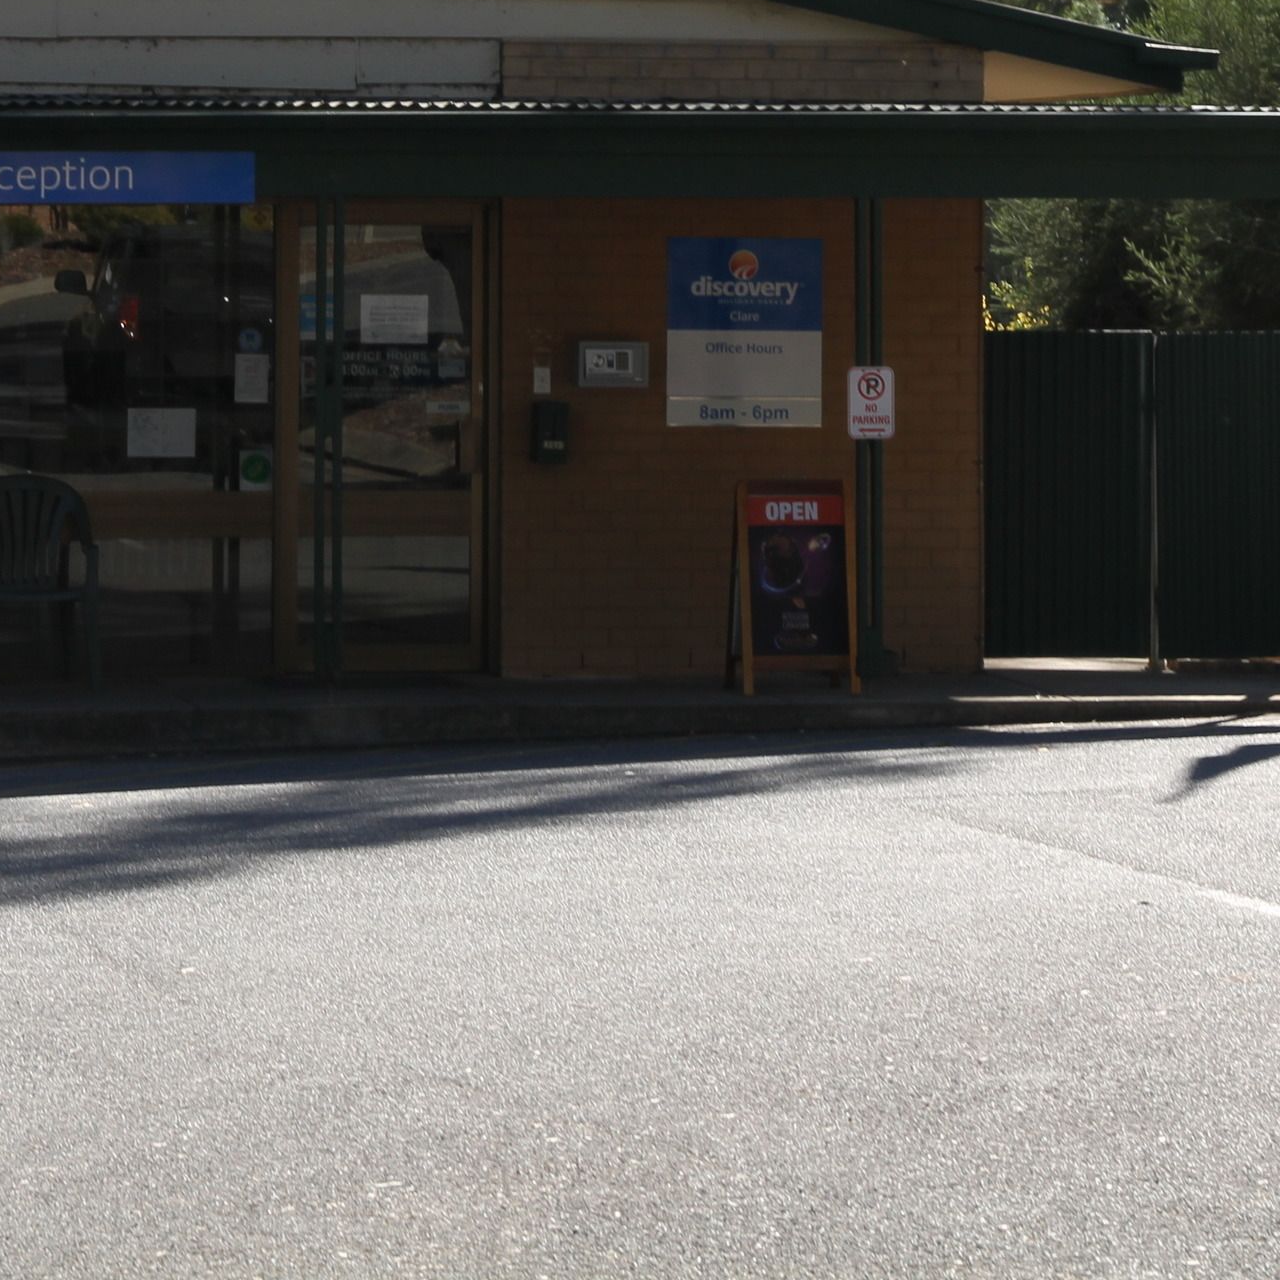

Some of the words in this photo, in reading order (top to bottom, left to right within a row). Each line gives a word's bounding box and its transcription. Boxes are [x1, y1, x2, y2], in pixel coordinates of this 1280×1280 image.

[690, 275, 799, 305] discovery
[729, 310, 760, 322] Clare
[705, 341, 743, 354] Office
[746, 342, 784, 354] Hours
[699, 404, 736, 420] 8am
[752, 404, 790, 423] 6pm
[865, 403, 878, 412] NO
[852, 415, 891, 425] PARKING
[765, 500, 819, 521] OPEN
